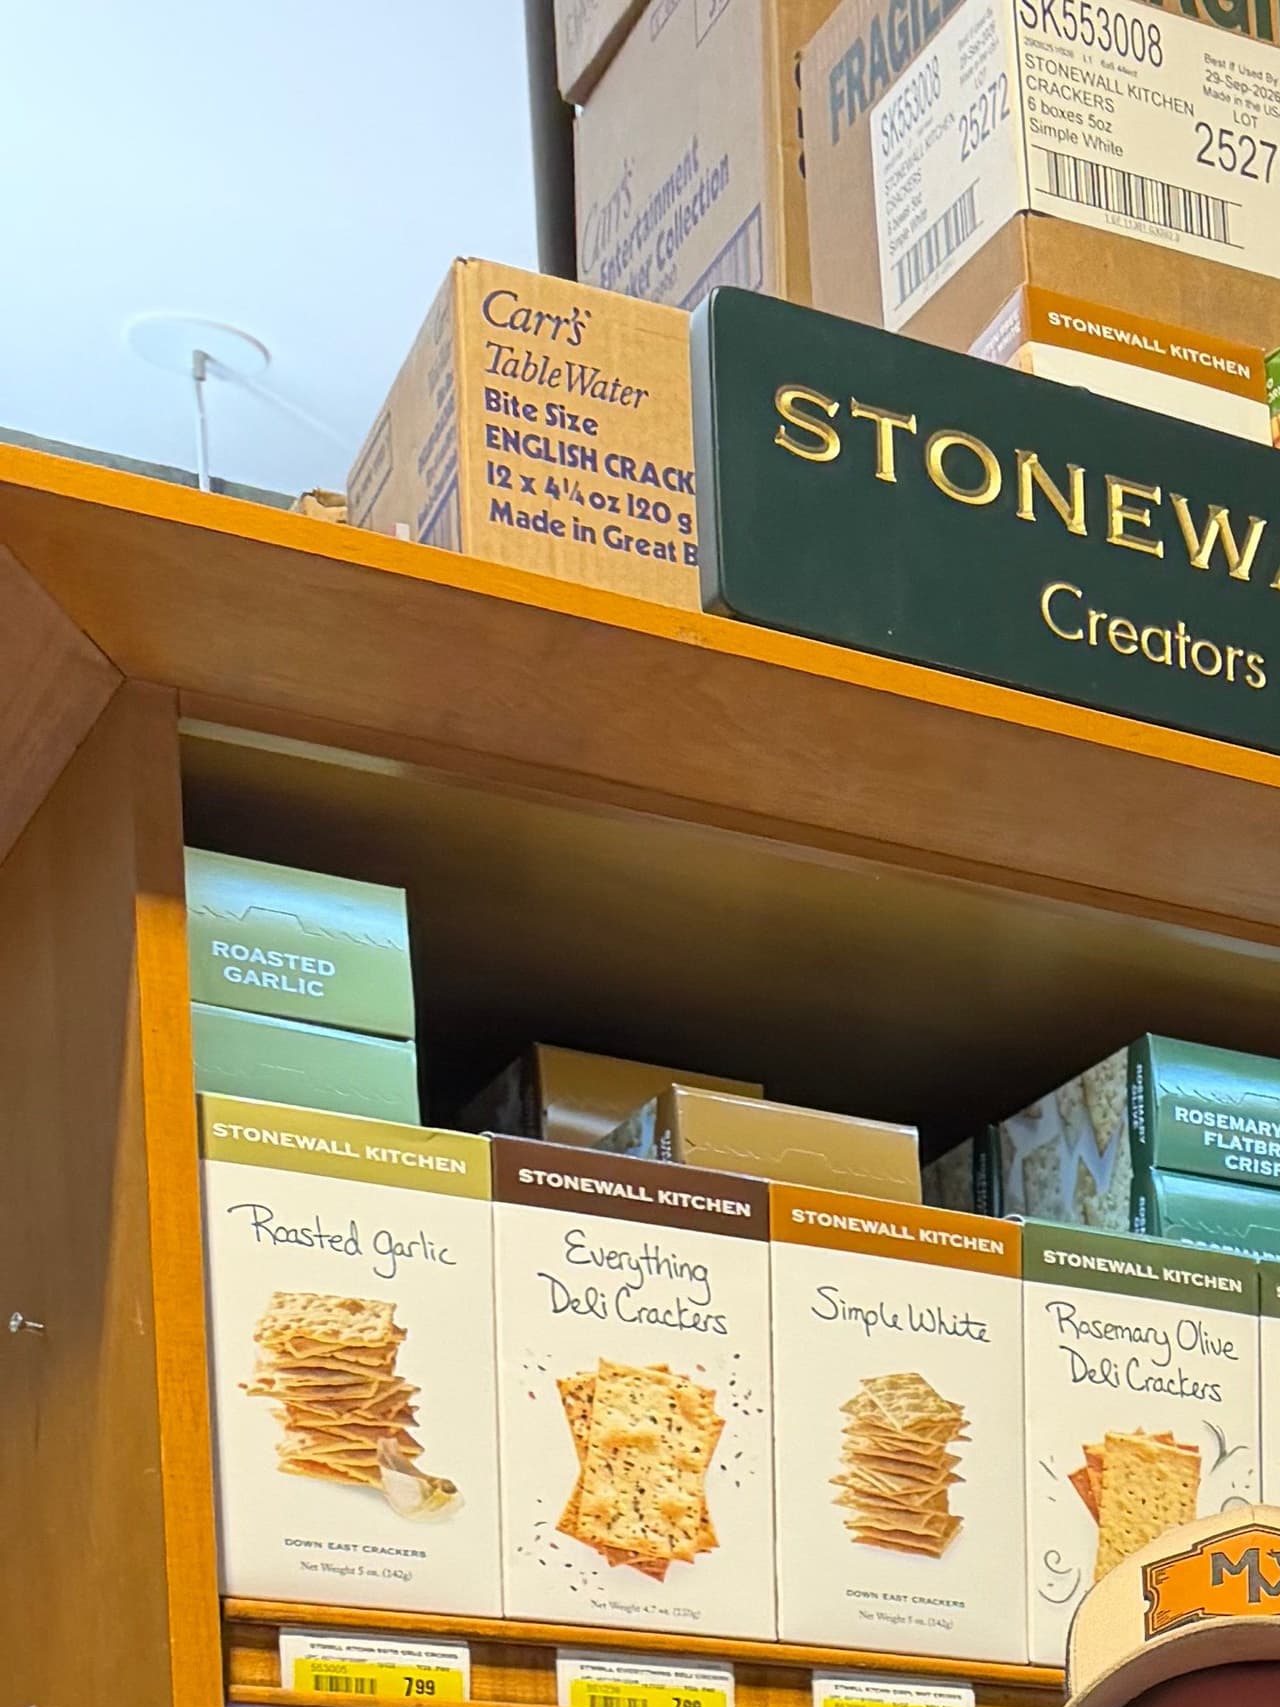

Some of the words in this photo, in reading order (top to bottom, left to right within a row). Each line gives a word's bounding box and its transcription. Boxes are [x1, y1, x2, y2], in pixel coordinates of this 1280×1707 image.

[1024, 52, 1124, 97] STONEWALL
[1128, 85, 1195, 117] KITCHEN
[1026, 76, 1116, 113] CRACKERS
[958, 71, 1011, 163] 25272
[1027, 95, 1038, 112] 6
[1041, 99, 1084, 126] boxes
[1088, 113, 1112, 134] 5oz
[1029, 117, 1079, 145] Simple
[1082, 130, 1124, 158] White
[1233, 110, 1258, 129] LOT
[482, 289, 592, 346] Carr's
[1047, 311, 1166, 358] STONEWALL
[1169, 342, 1252, 380] KITCHEN
[484, 387, 538, 422] Bite
[545, 401, 599, 436] Size
[486, 424, 598, 472] ENGLISH
[487, 461, 512, 489] 12
[520, 474, 537, 495] x
[588, 492, 621, 513] oz
[627, 493, 671, 523] 120
[678, 512, 692, 534] g
[490, 499, 566, 537] Made
[573, 518, 596, 544] in
[603, 526, 676, 563] Great
[1041, 580, 1268, 689] Creators
[211, 940, 335, 977] ROASTED
[223, 966, 325, 997] GARLIC
[213, 1123, 360, 1158] STONEWALL
[365, 1146, 467, 1174] KITCHEN
[518, 1168, 653, 1203] STONEWALL
[657, 1188, 752, 1218] KITCHEN
[227, 1204, 362, 1256] Roasted
[790, 1208, 914, 1241] STONEWALL
[918, 1227, 1004, 1256] KITCHEN
[564, 1229, 712, 1305] Everything
[537, 1273, 608, 1315] Deli
[616, 1285, 729, 1336] Crackers
[811, 1286, 904, 1338] Simple
[908, 1303, 992, 1344] White
[1045, 1301, 1172, 1367] Rosemary
[1177, 1319, 1239, 1361] Olive
[284, 1538, 322, 1550] DOWN
[327, 1542, 358, 1554] EAST
[362, 1545, 427, 1558] CRACKERS
